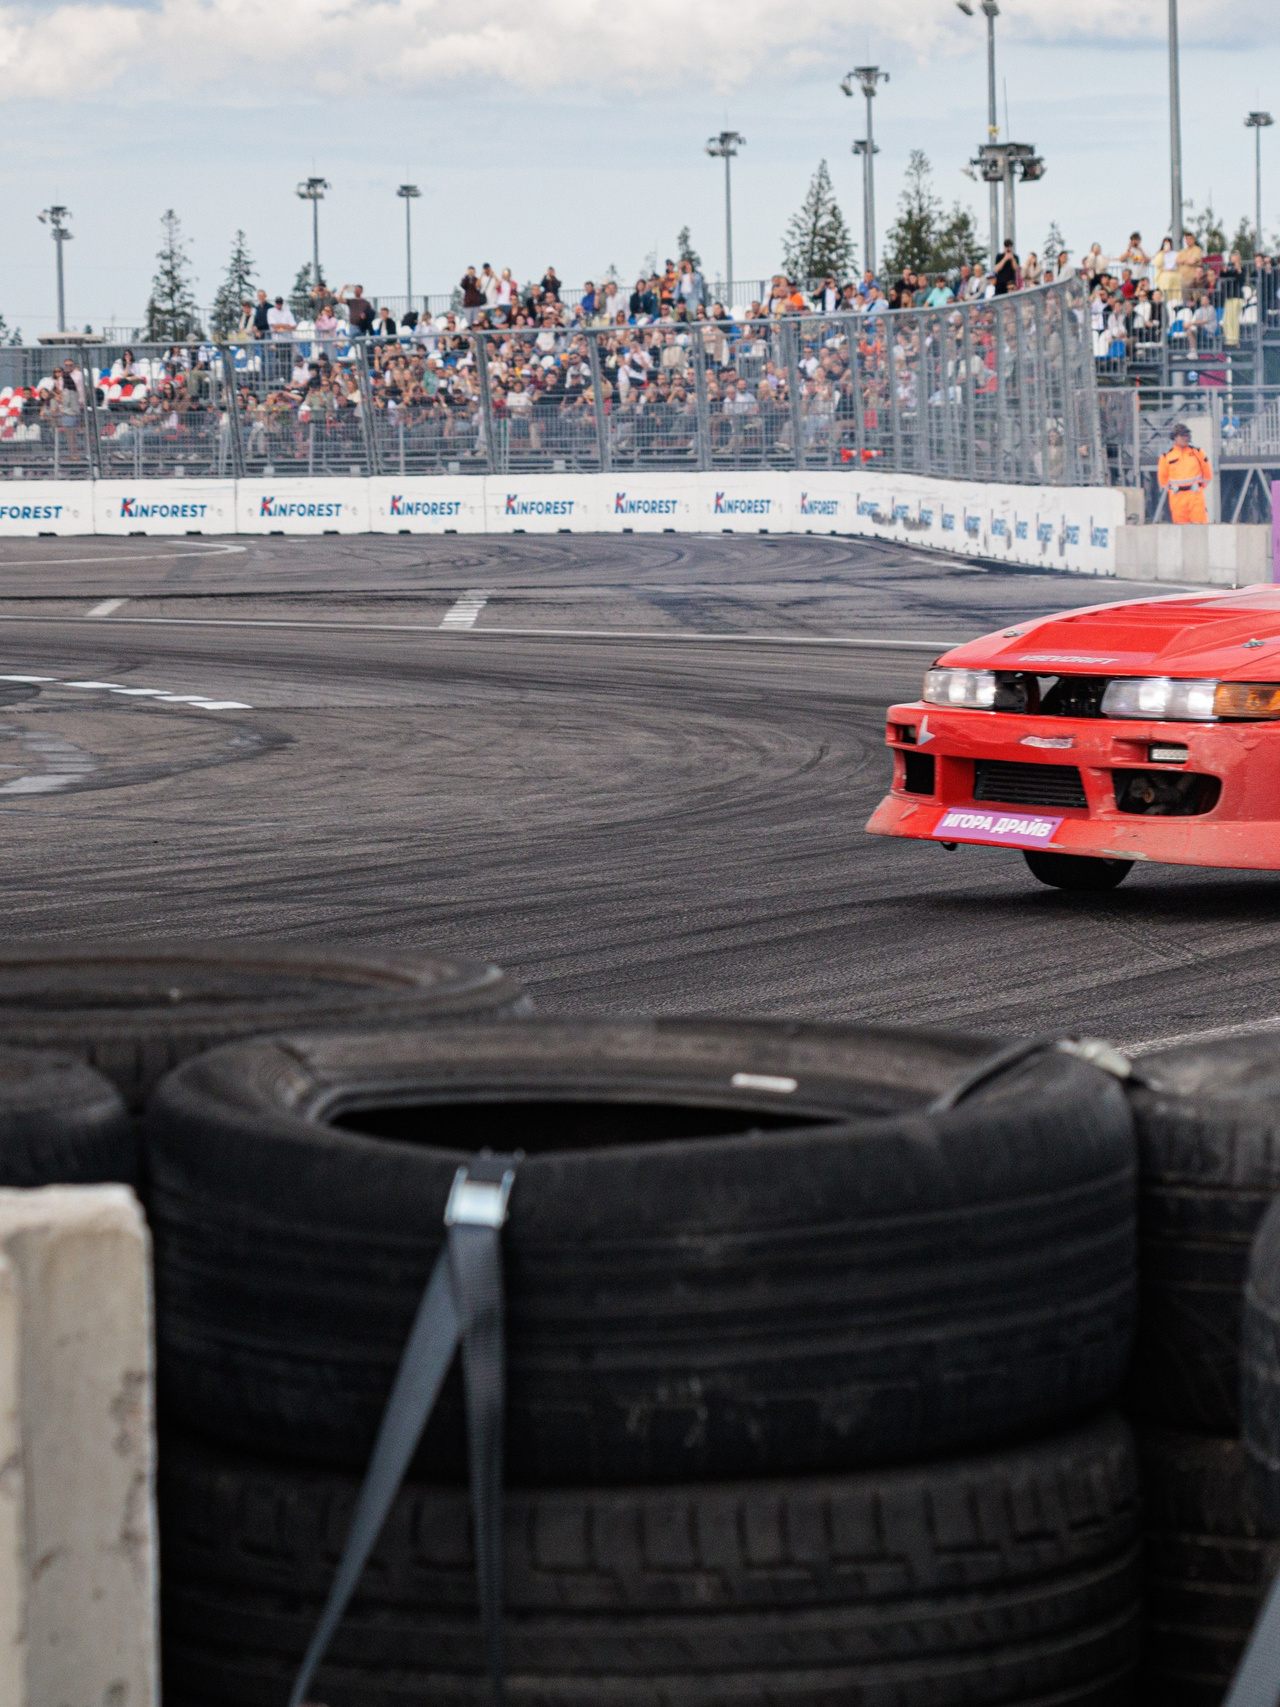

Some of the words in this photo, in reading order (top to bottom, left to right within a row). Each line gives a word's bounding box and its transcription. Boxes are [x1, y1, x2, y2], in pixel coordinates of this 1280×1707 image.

[120, 498, 207, 518] KINFOREST
[260, 496, 342, 517] KINFOREST
[390, 495, 461, 516] KINFOREST
[505, 494, 574, 515] KINFOREST
[614, 492, 677, 514] KINFOREST
[714, 492, 771, 514] KINFOREST
[942, 813, 993, 830] ИГОРА
[990, 817, 1053, 837] ДРАЙВ
